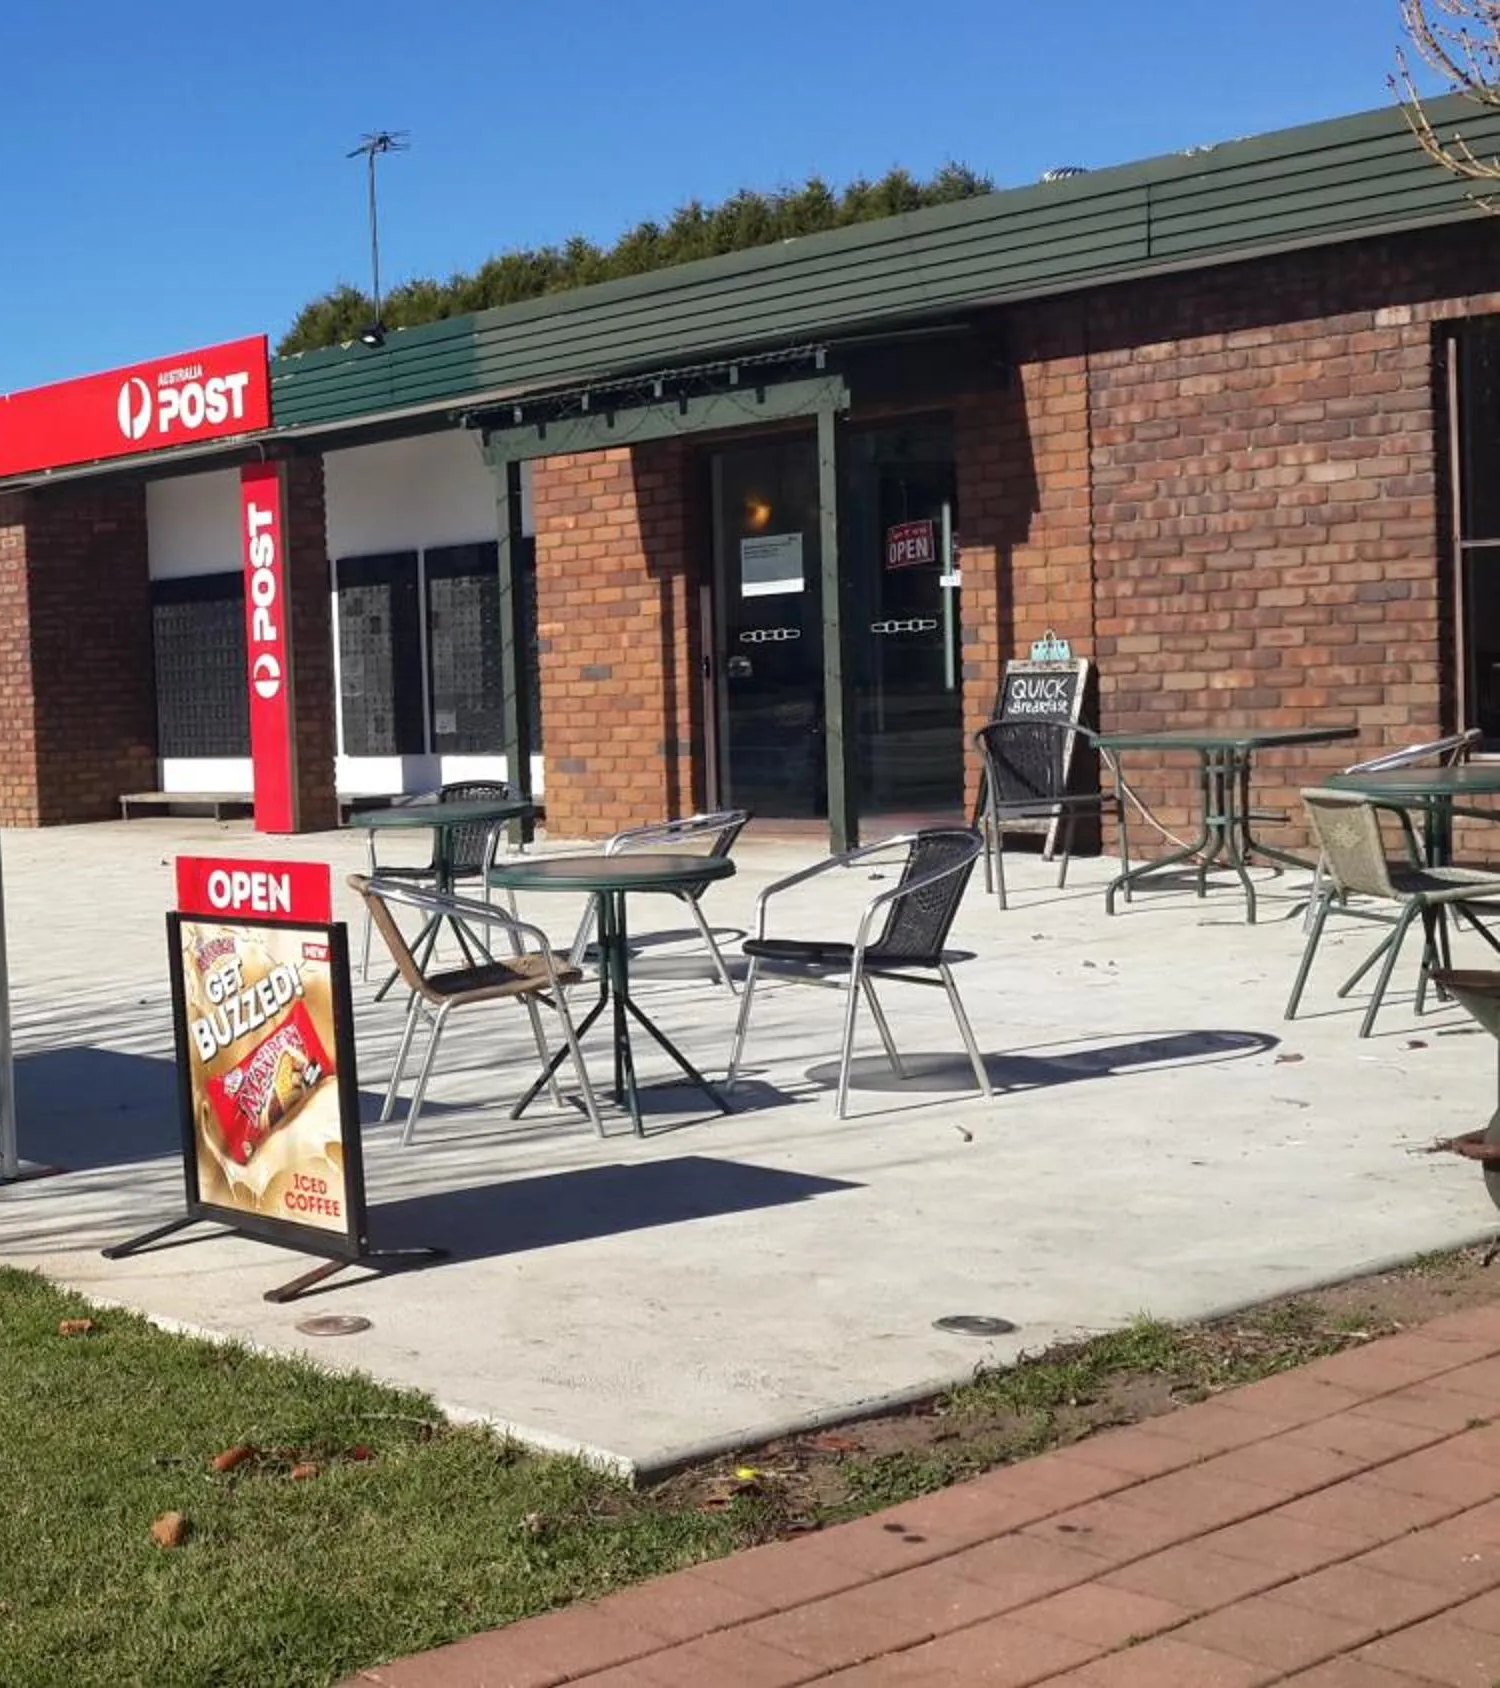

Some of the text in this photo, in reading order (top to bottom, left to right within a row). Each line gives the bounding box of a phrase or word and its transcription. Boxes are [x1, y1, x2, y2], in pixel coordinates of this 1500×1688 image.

[158, 364, 203, 387] AUSTRALIA
[158, 371, 249, 433] POST
[889, 535, 929, 565] OPEN
[248, 502, 277, 641] POST
[1011, 678, 1069, 699] QUICK
[207, 869, 291, 913] OPEN
[205, 959, 245, 1005] GET
[191, 961, 305, 1064] BUZZED!
[293, 1173, 328, 1195] ICED
[284, 1191, 341, 1217] COFFEE
